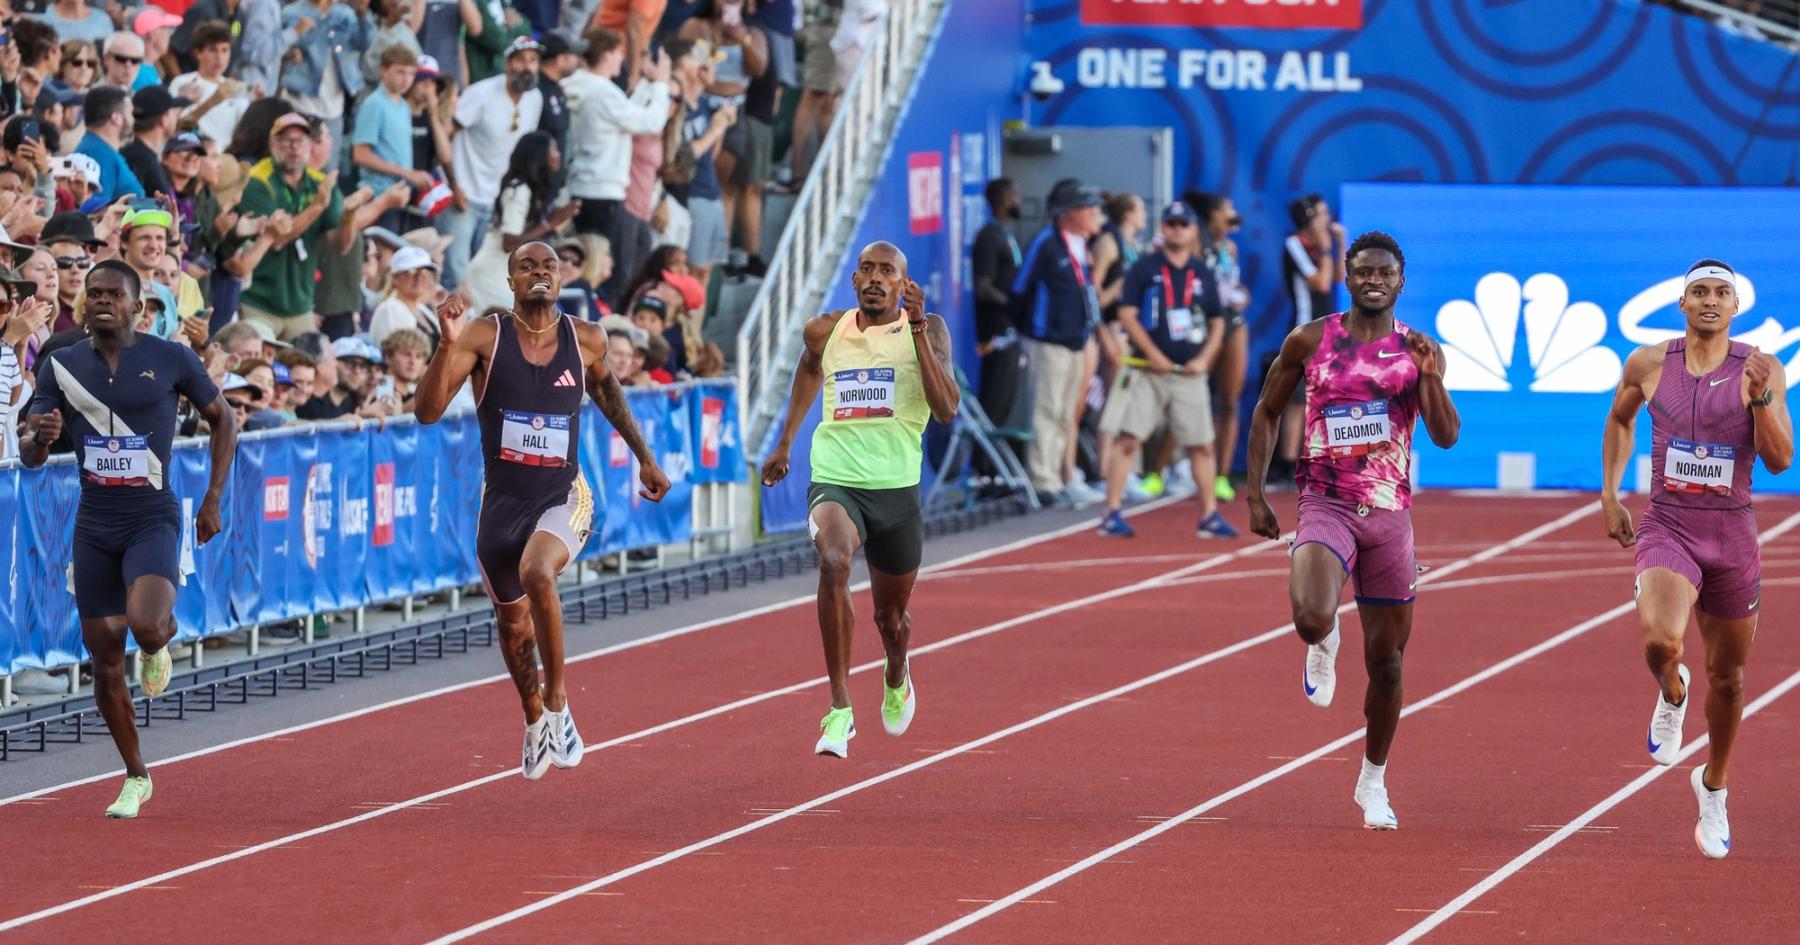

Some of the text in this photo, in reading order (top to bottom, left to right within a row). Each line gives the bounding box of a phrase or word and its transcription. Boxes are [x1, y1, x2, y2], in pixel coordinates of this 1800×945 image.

[1077, 47, 1363, 92] ONE FOR ALL
[840, 388, 887, 403] NORWOOD
[1334, 421, 1383, 441] DEADMON
[522, 434, 549, 449] HALL
[96, 457, 132, 471] BAILEY
[1676, 461, 1722, 478] NORMAN
